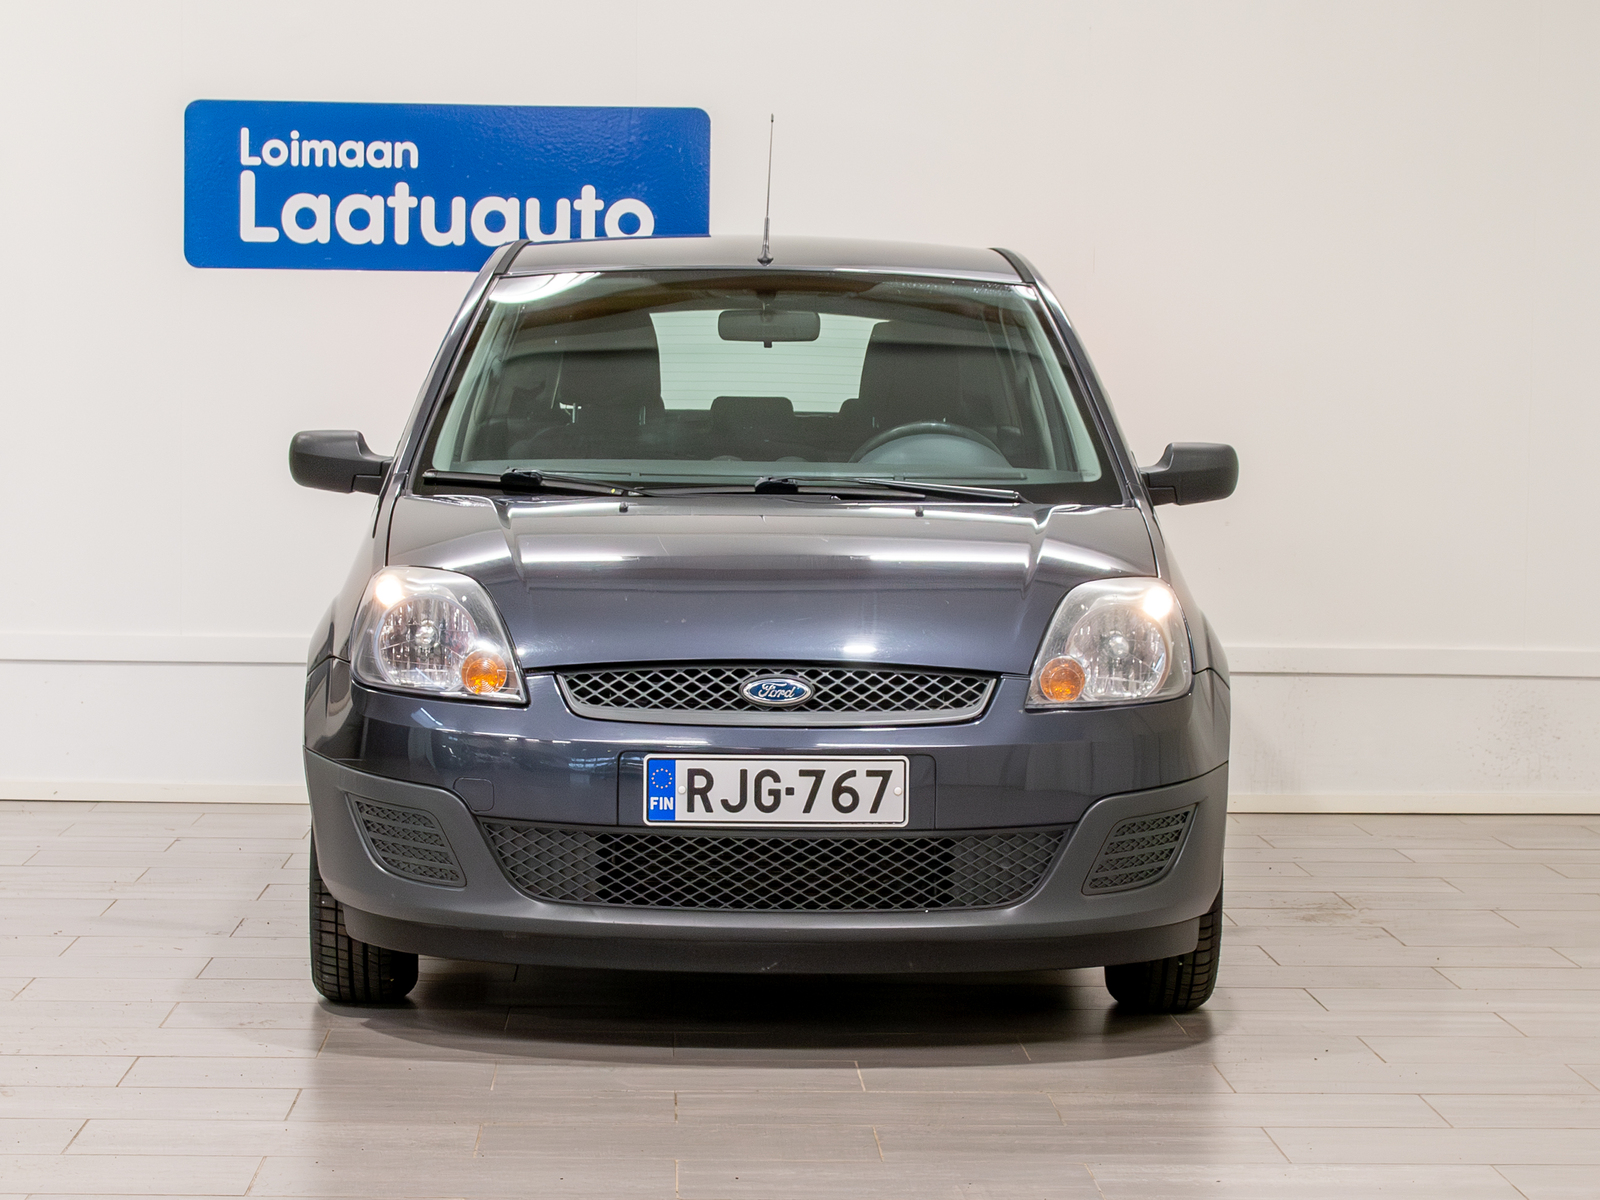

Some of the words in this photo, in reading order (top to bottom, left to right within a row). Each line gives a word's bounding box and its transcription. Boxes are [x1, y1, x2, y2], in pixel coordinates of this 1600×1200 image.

[240, 127, 419, 168] Loimaan
[240, 170, 655, 246] Laatuauto
[757, 681, 796, 699] Ford
[649, 797, 674, 811] FIN
[686, 768, 893, 814] RJG-767
